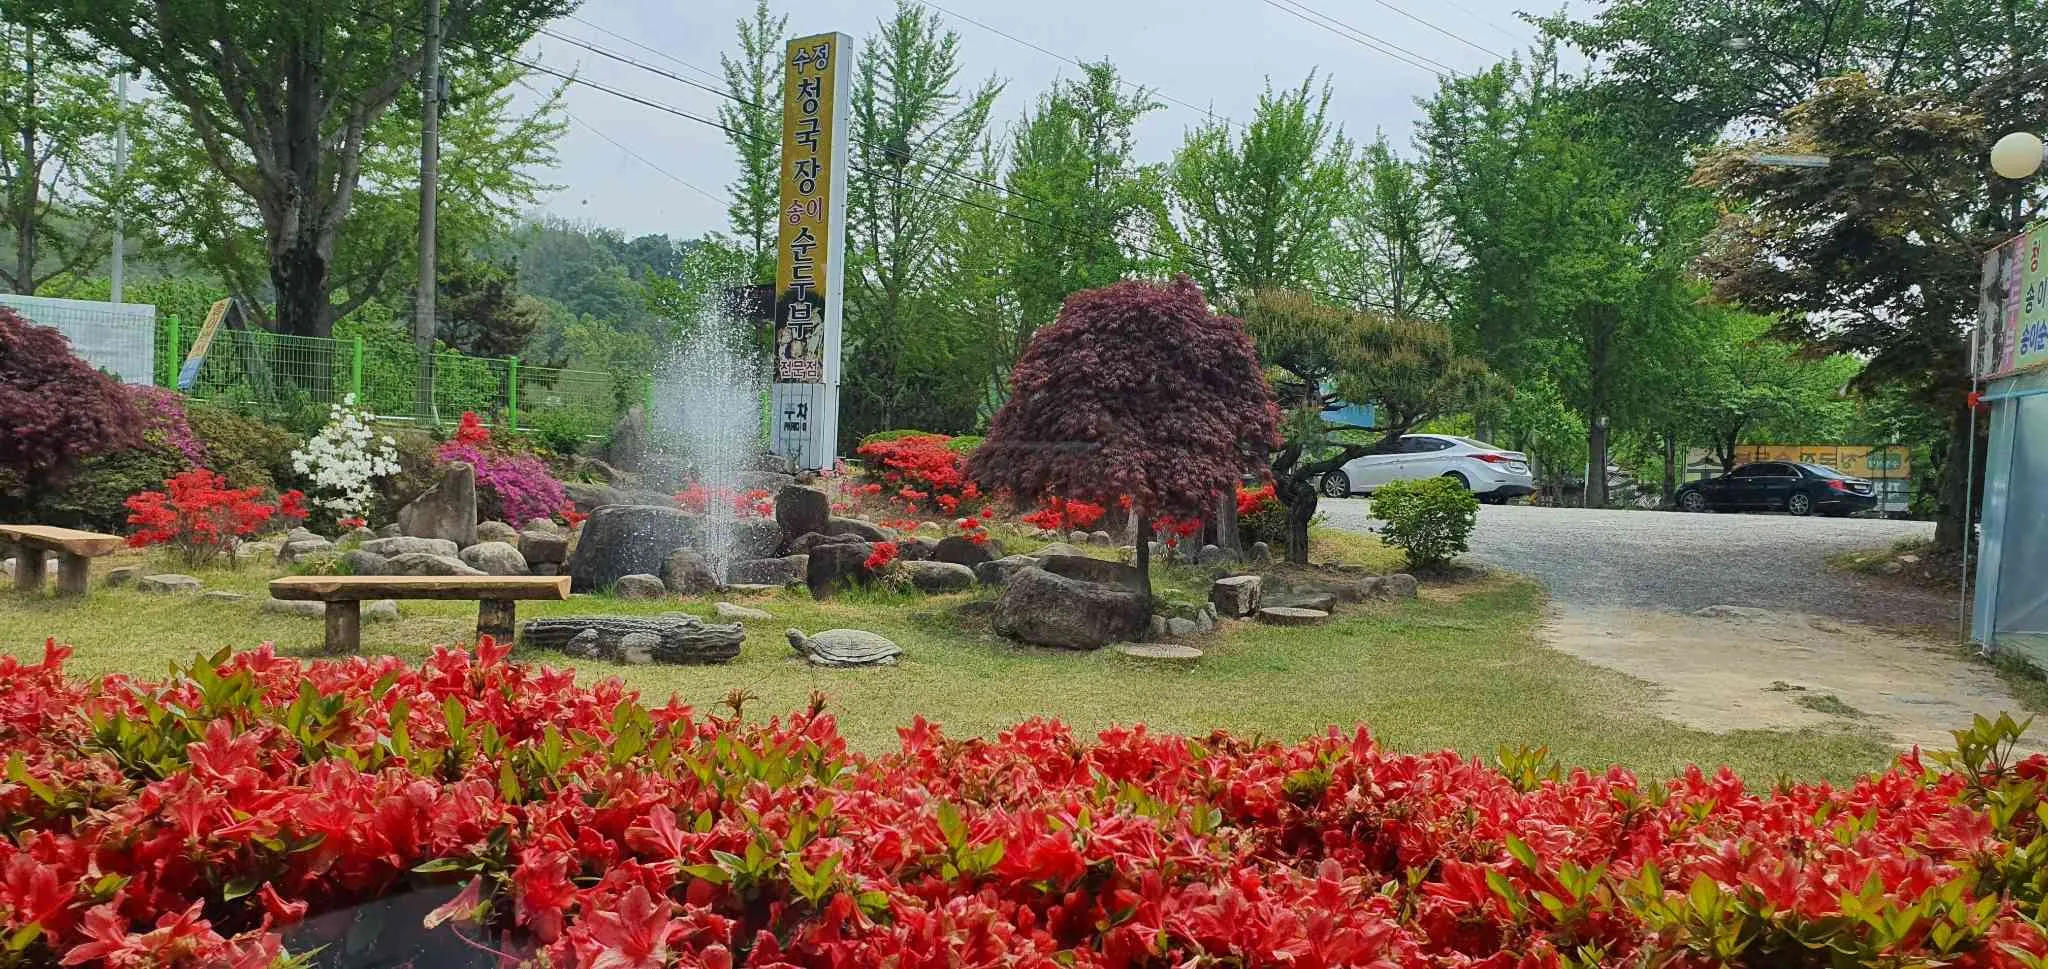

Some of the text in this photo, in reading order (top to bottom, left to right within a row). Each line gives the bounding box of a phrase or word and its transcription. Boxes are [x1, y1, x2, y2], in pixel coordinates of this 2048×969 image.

[792, 42, 830, 73] 수정
[792, 76, 822, 197] 청국장
[784, 197, 824, 225] 송이
[787, 227, 817, 340] 순두부
[780, 359, 818, 379] 전문점
